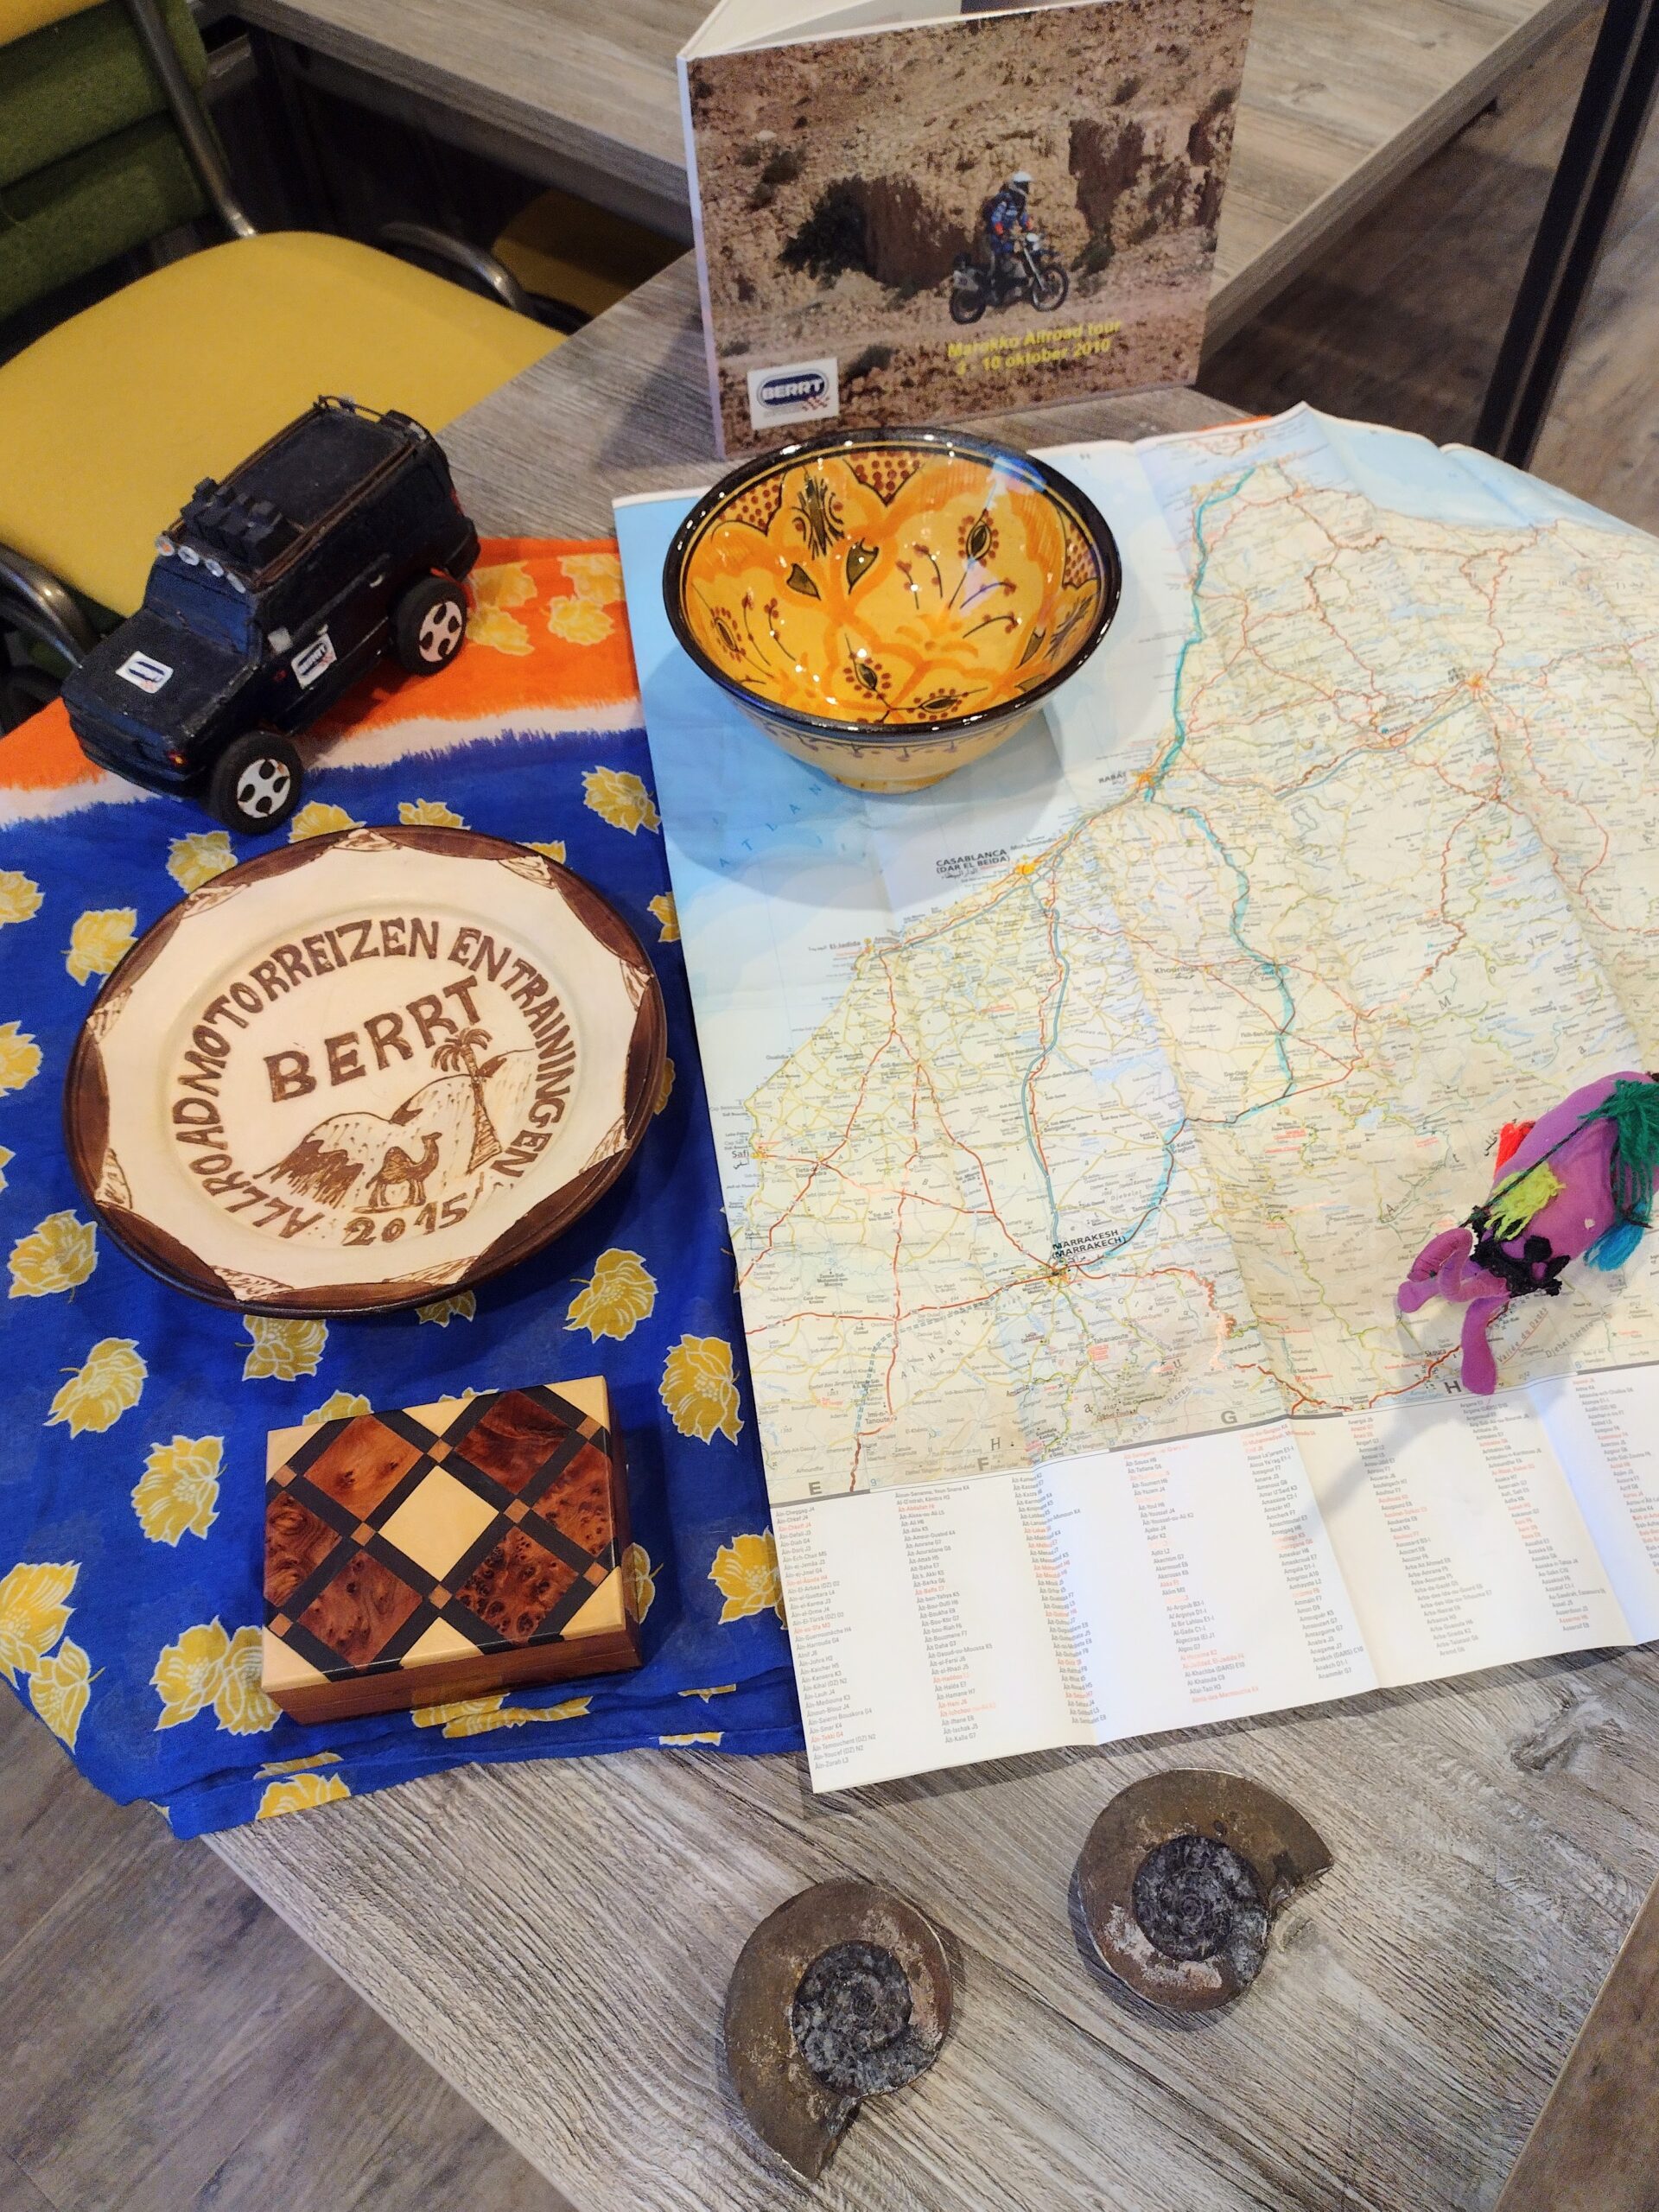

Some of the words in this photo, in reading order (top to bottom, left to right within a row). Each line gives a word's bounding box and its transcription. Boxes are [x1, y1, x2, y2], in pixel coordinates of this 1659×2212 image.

[936, 849, 1007, 867] CASABLANCA
[937, 864, 961, 874] (DAR
[963, 861, 975, 870] EL
[263, 975, 478, 1103] BERRT
[732, 1149, 749, 1159] Safi
[343, 1192, 468, 1247] 2015
[1052, 1230, 1120, 1251] MARRAKESH
[1052, 1235, 1127, 1261] (MARRAKECH)
[1546, 1338, 1570, 1358] Djebel
[1444, 1380, 1461, 1395] H
[1221, 1410, 1238, 1425] G
[977, 1457, 990, 1471] F
[809, 1481, 822, 1496] E
